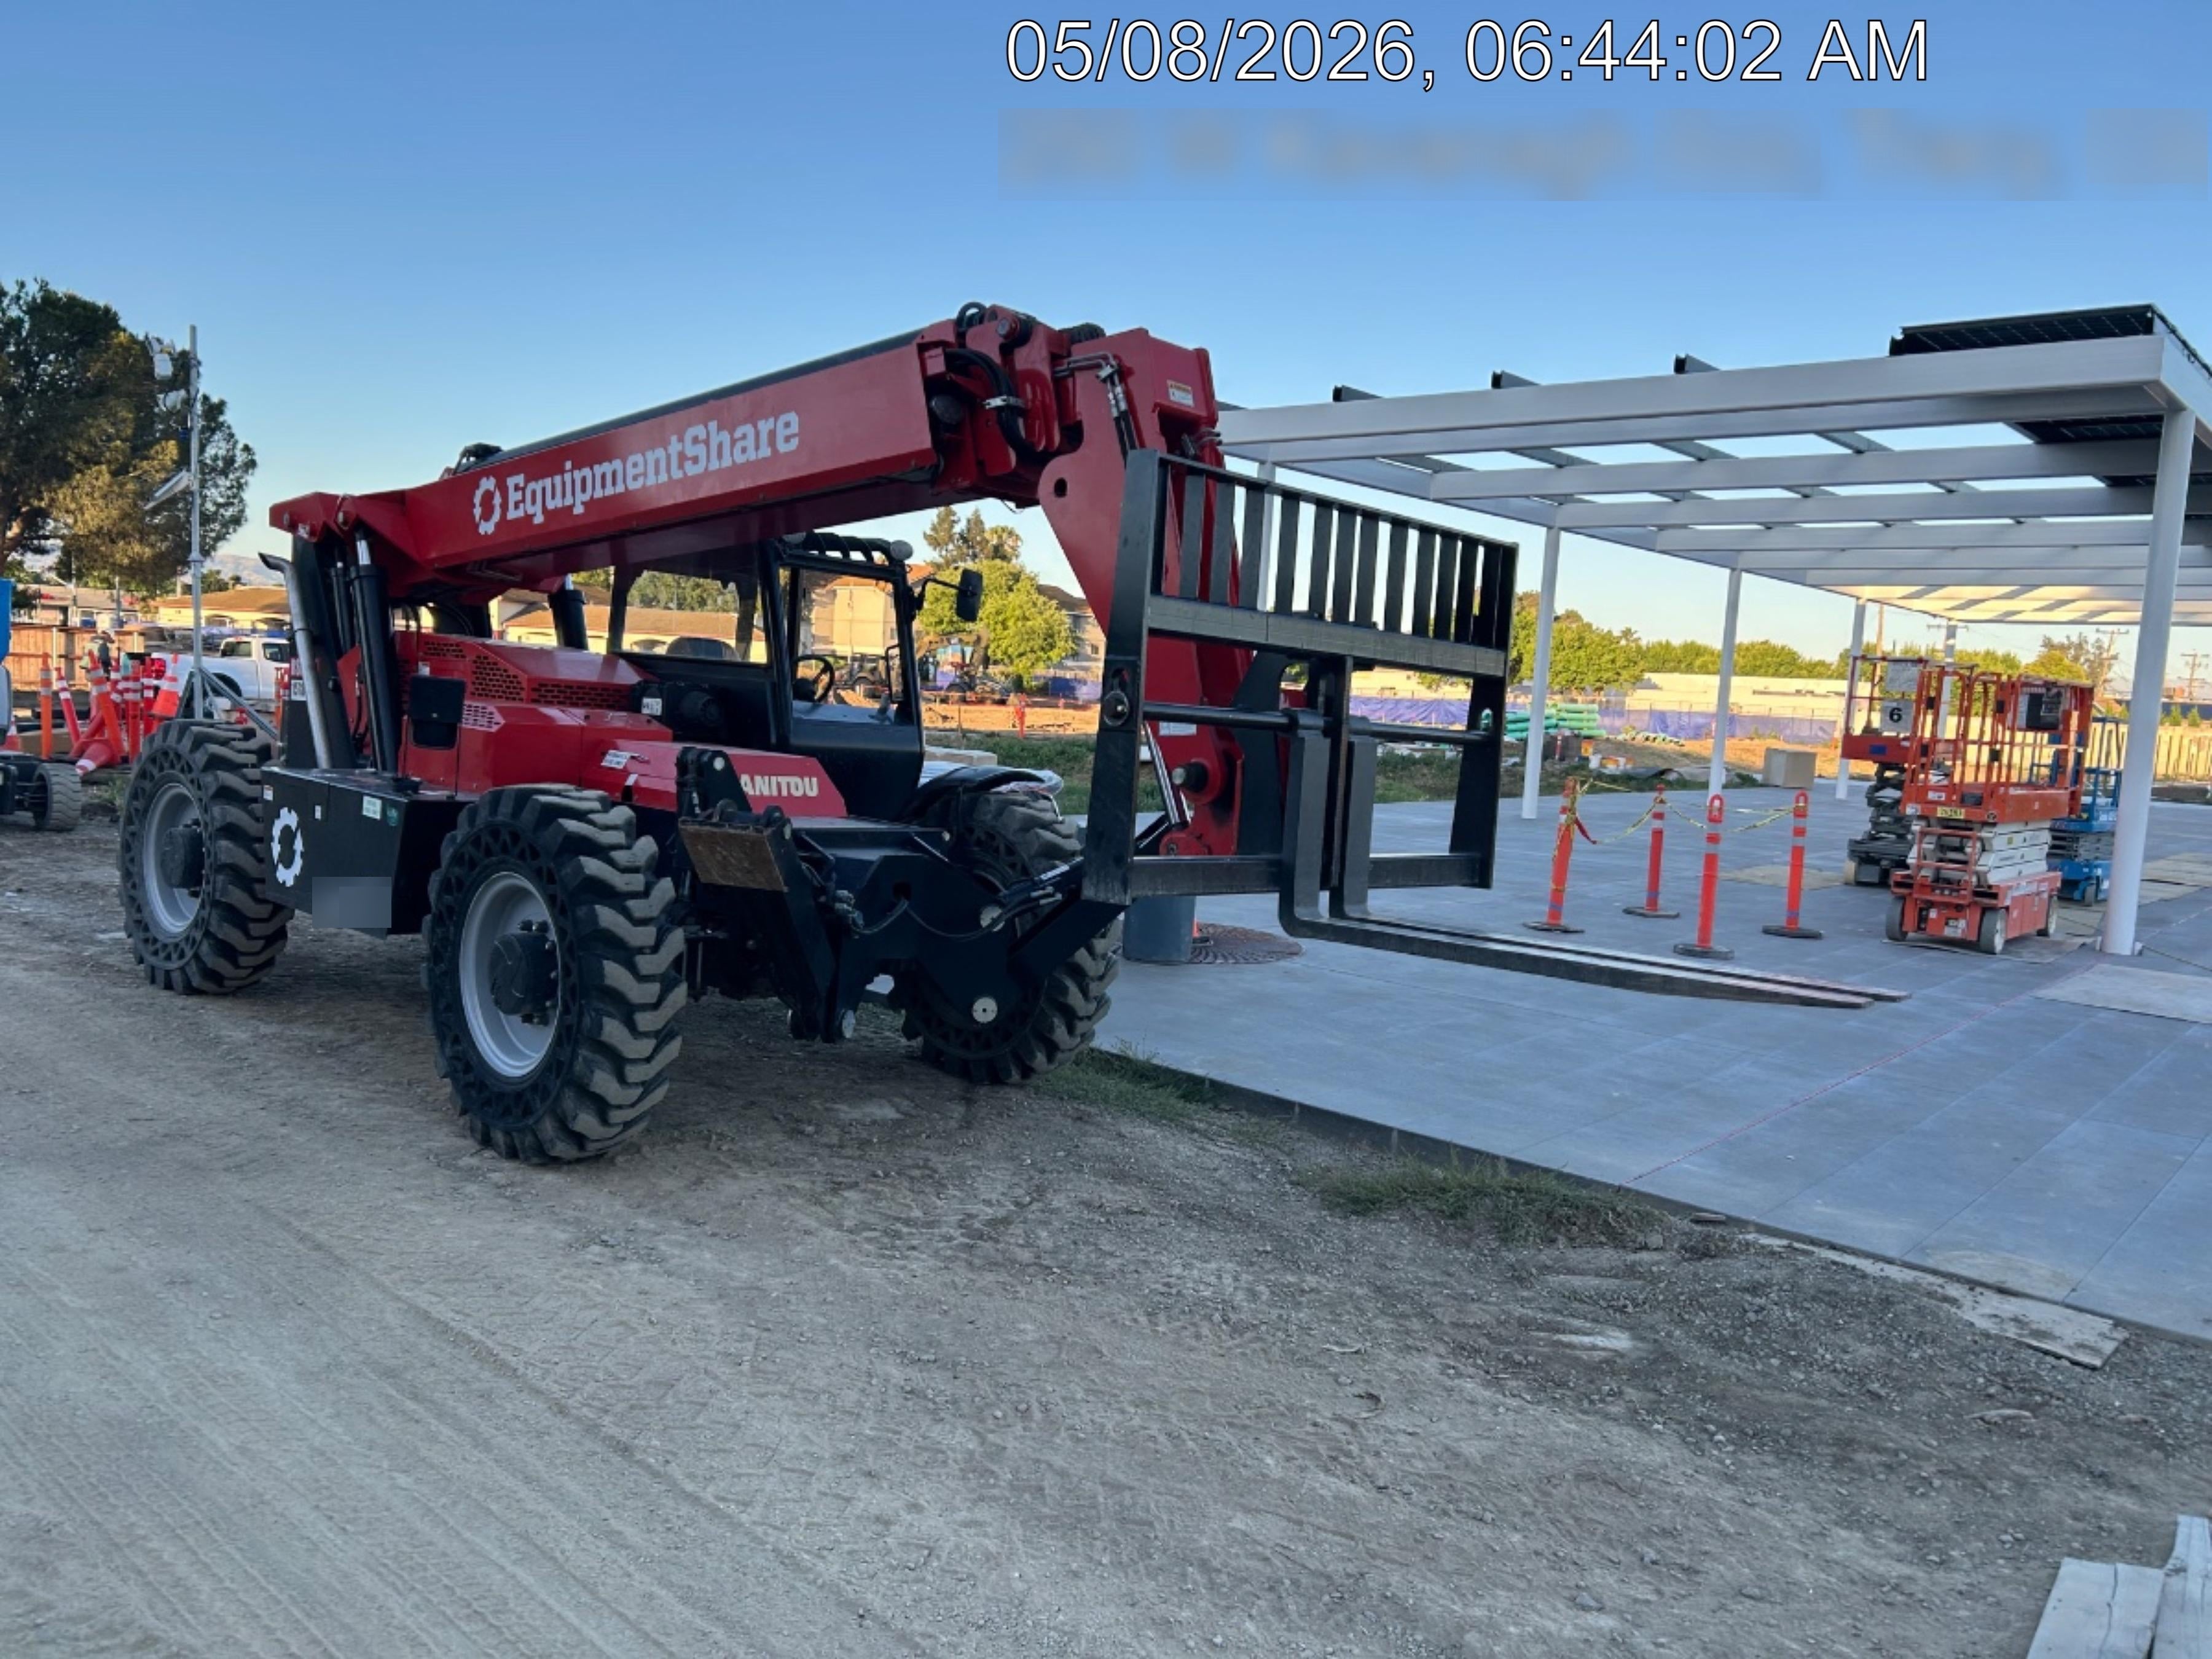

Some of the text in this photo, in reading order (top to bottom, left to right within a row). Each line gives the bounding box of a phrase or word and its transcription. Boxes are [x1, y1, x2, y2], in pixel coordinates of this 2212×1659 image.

[506, 410, 799, 524] EquipmentShare
[1889, 707, 1903, 723] 6
[740, 774, 818, 797] ANITOU
